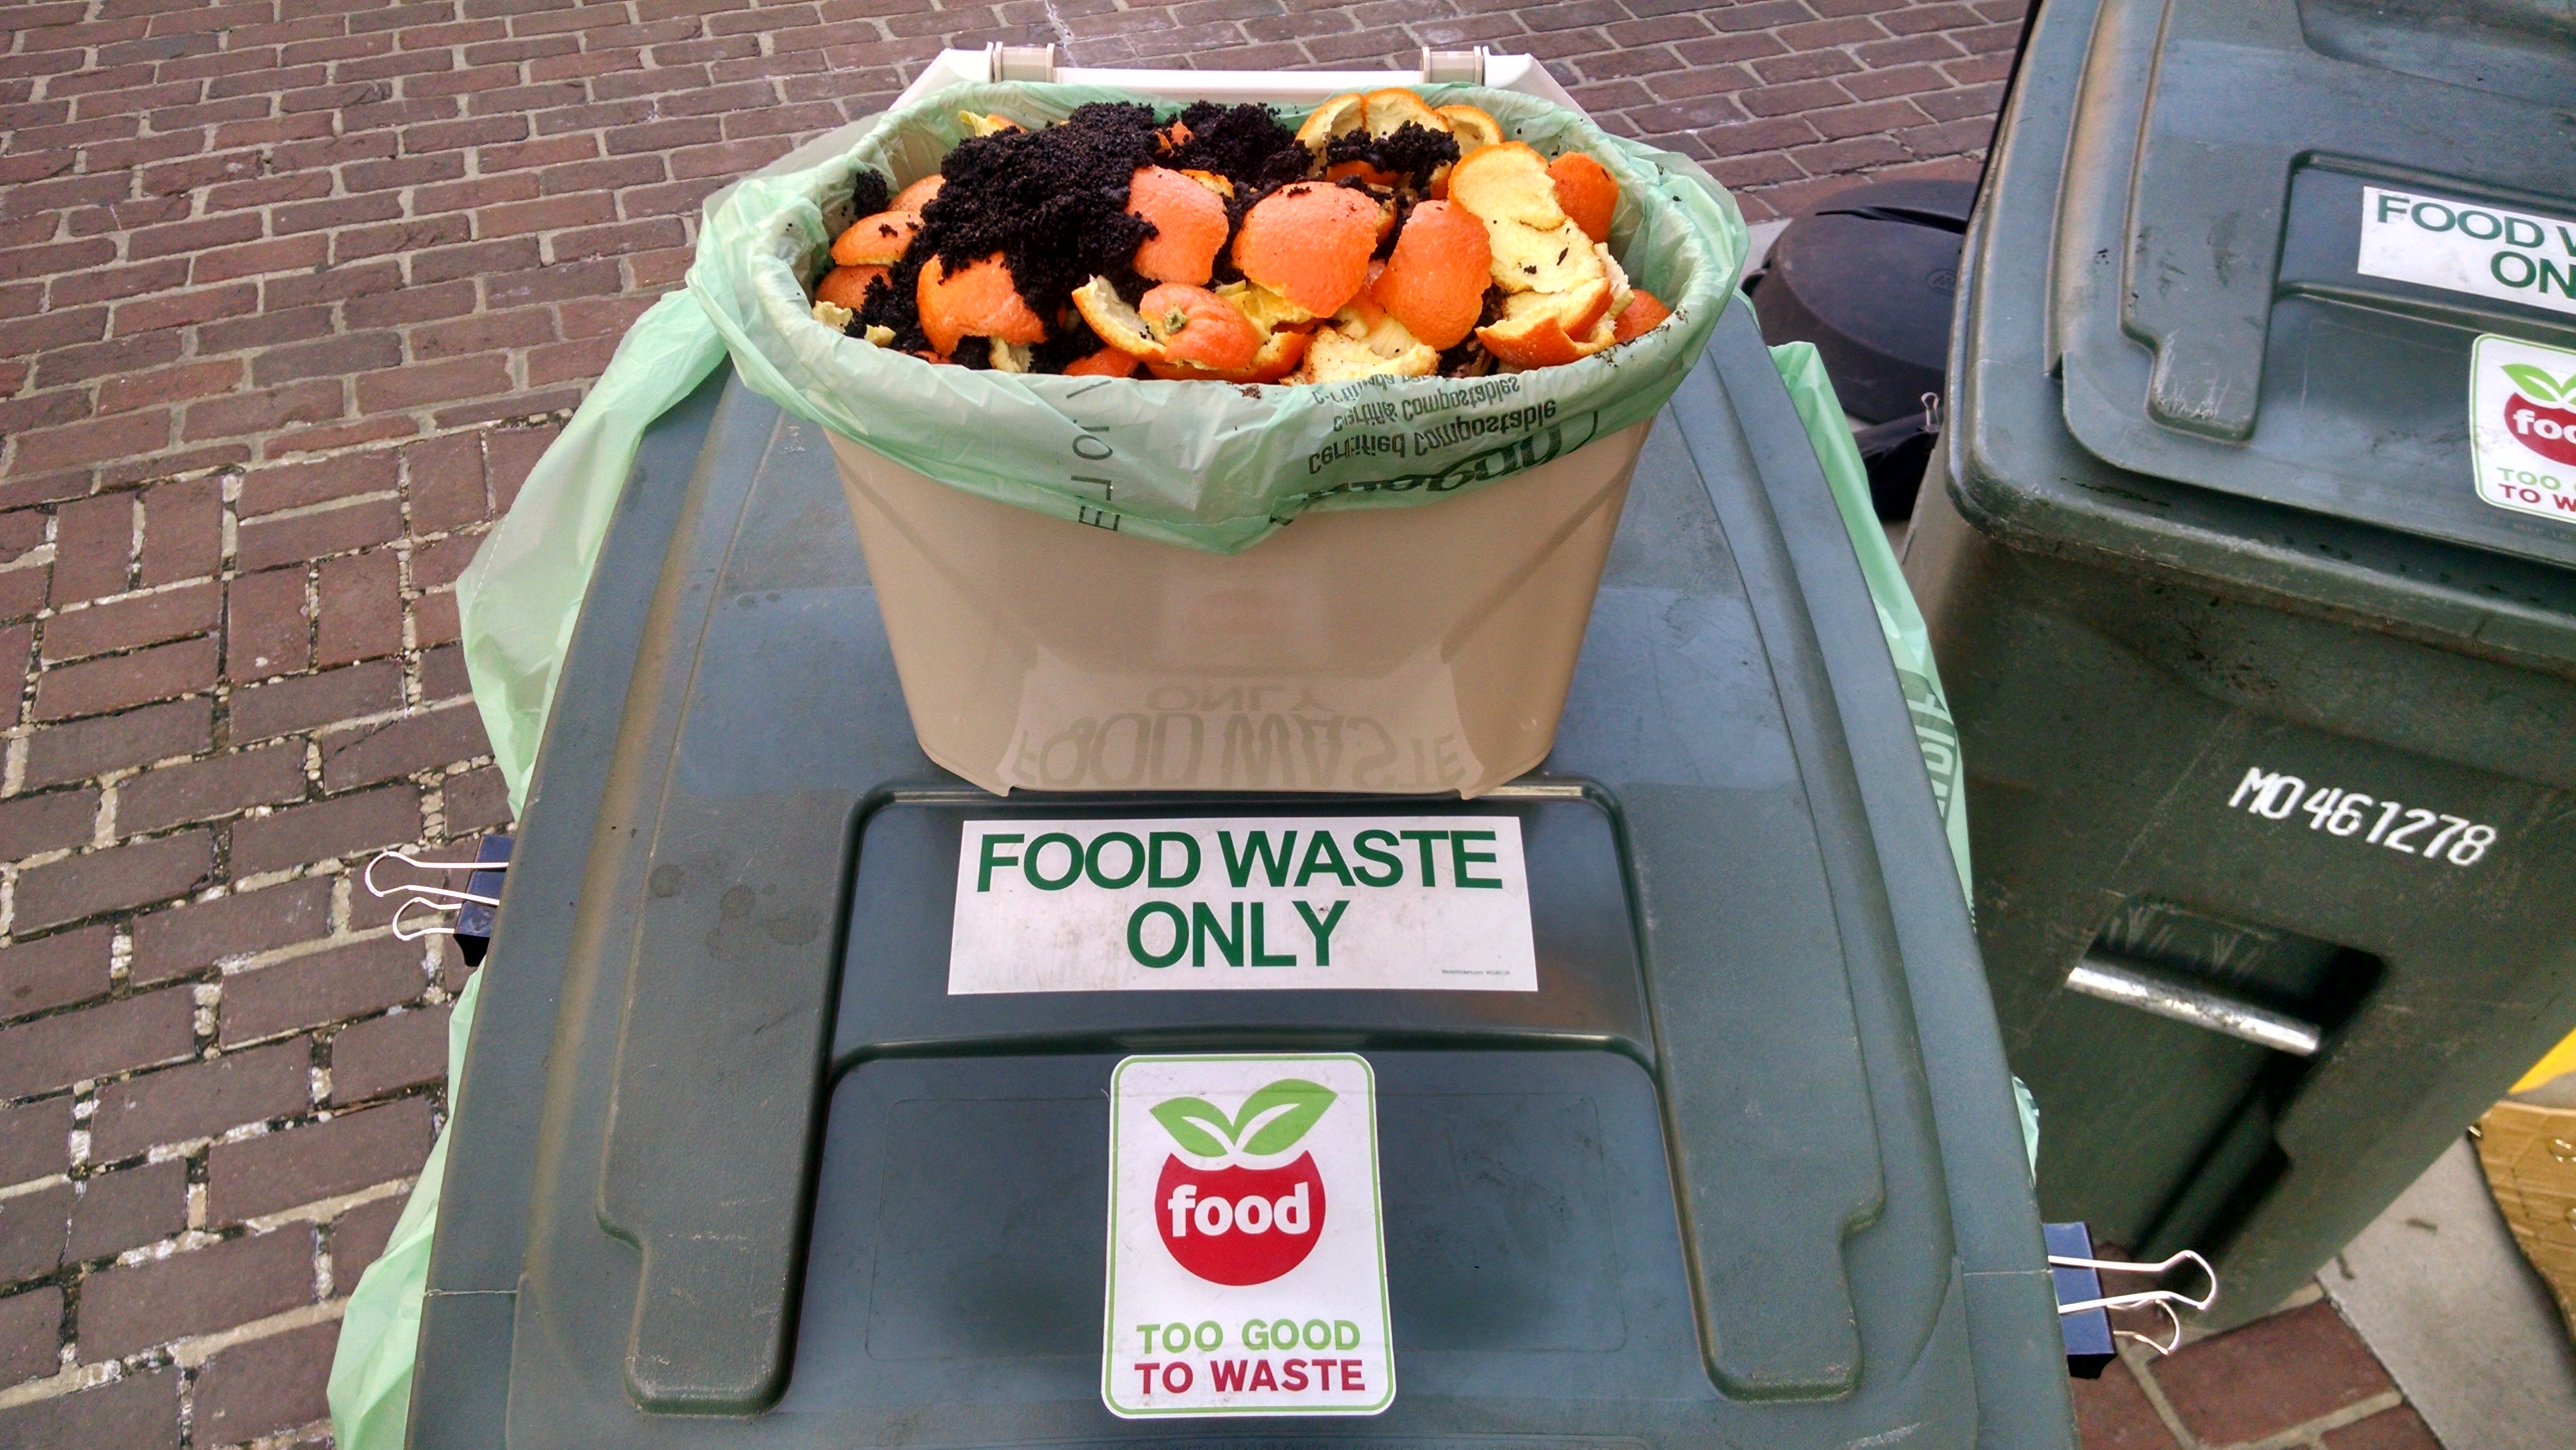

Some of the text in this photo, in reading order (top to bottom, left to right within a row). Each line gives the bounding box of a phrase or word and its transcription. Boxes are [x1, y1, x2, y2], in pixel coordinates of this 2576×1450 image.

[2377, 194, 2545, 249] FOOD
[2497, 467, 2561, 490] TOO
[2498, 483, 2541, 504] TO
[977, 829, 1503, 892] FOOD WASTE
[1126, 900, 1349, 968] ONLY
[1167, 1181, 1311, 1237] food
[1136, 1318, 1361, 1354] TOO GOOD
[1134, 1359, 1366, 1394] TO WASTE
